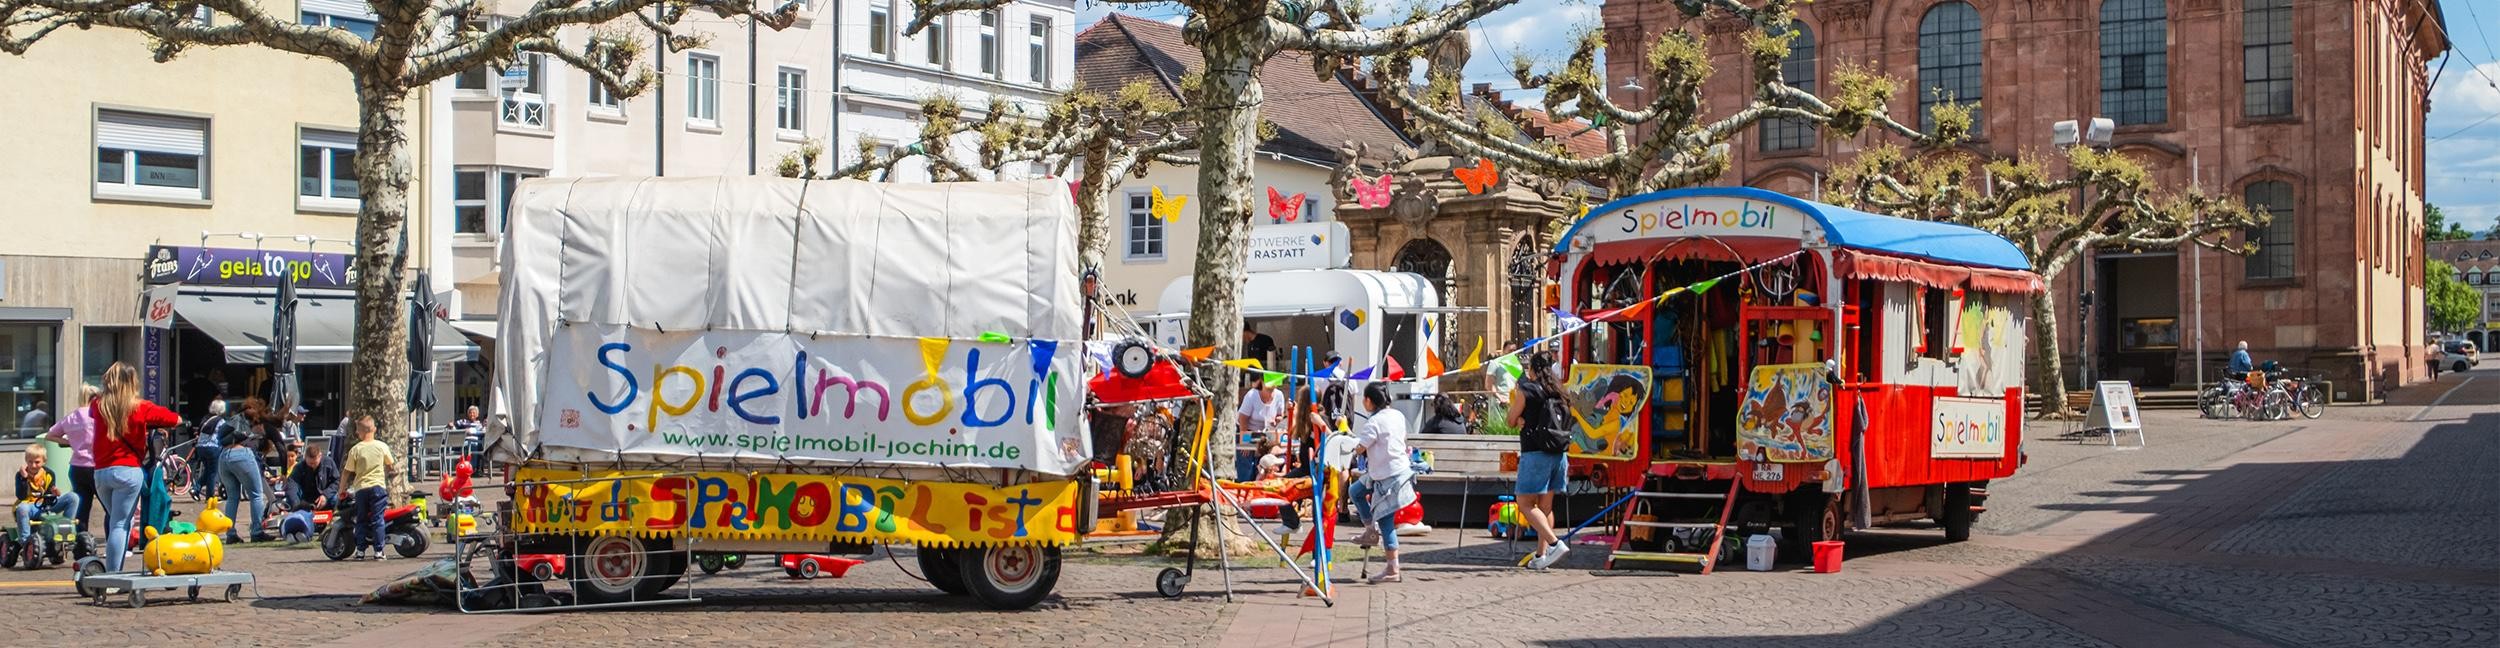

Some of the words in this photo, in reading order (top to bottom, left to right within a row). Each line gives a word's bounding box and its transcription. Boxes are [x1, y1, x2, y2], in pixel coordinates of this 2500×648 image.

[1621, 201, 1775, 236] Spielmobil
[1249, 235, 1305, 248] DTWERKE
[1254, 248, 1306, 259] RASTATT
[151, 297, 173, 322] Eis
[1099, 289, 1137, 306] ank
[587, 342, 1059, 433] Spielmobil
[1937, 410, 2001, 449] Spielmobil
[662, 431, 1021, 460] www.spielmobil-jochim.de
[963, 489, 1043, 539] ist
